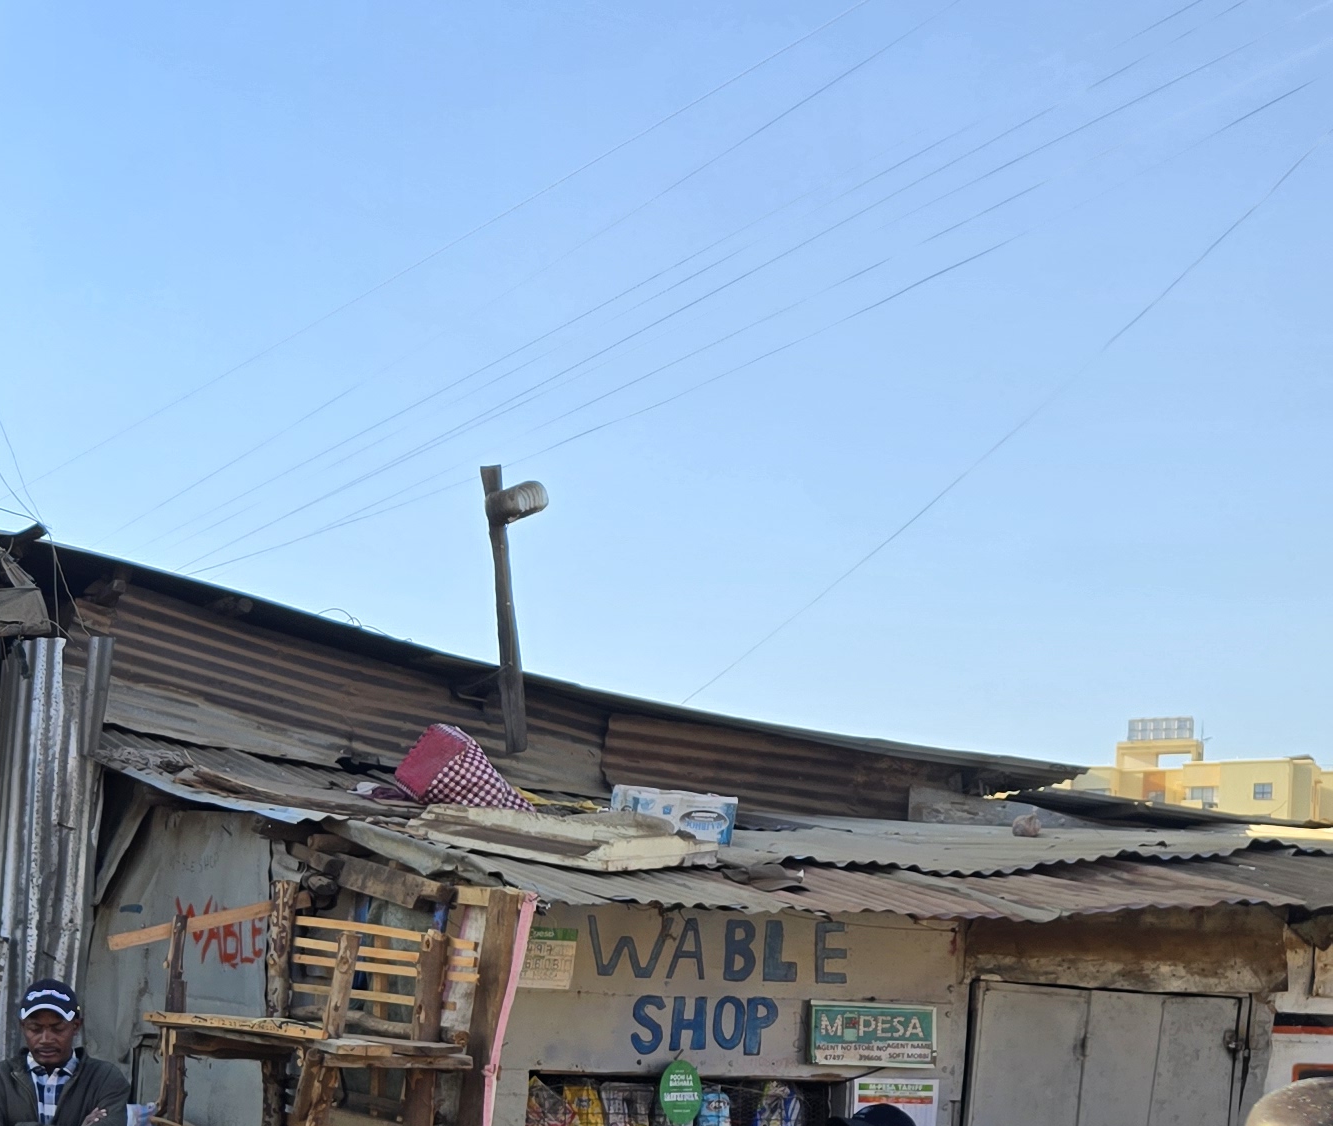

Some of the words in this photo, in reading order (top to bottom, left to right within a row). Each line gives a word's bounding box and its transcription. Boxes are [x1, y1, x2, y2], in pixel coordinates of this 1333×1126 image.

[587, 914, 848, 984] WABLE
[630, 995, 779, 1056] SHOP
[887, 1042, 909, 1050] AGENT
